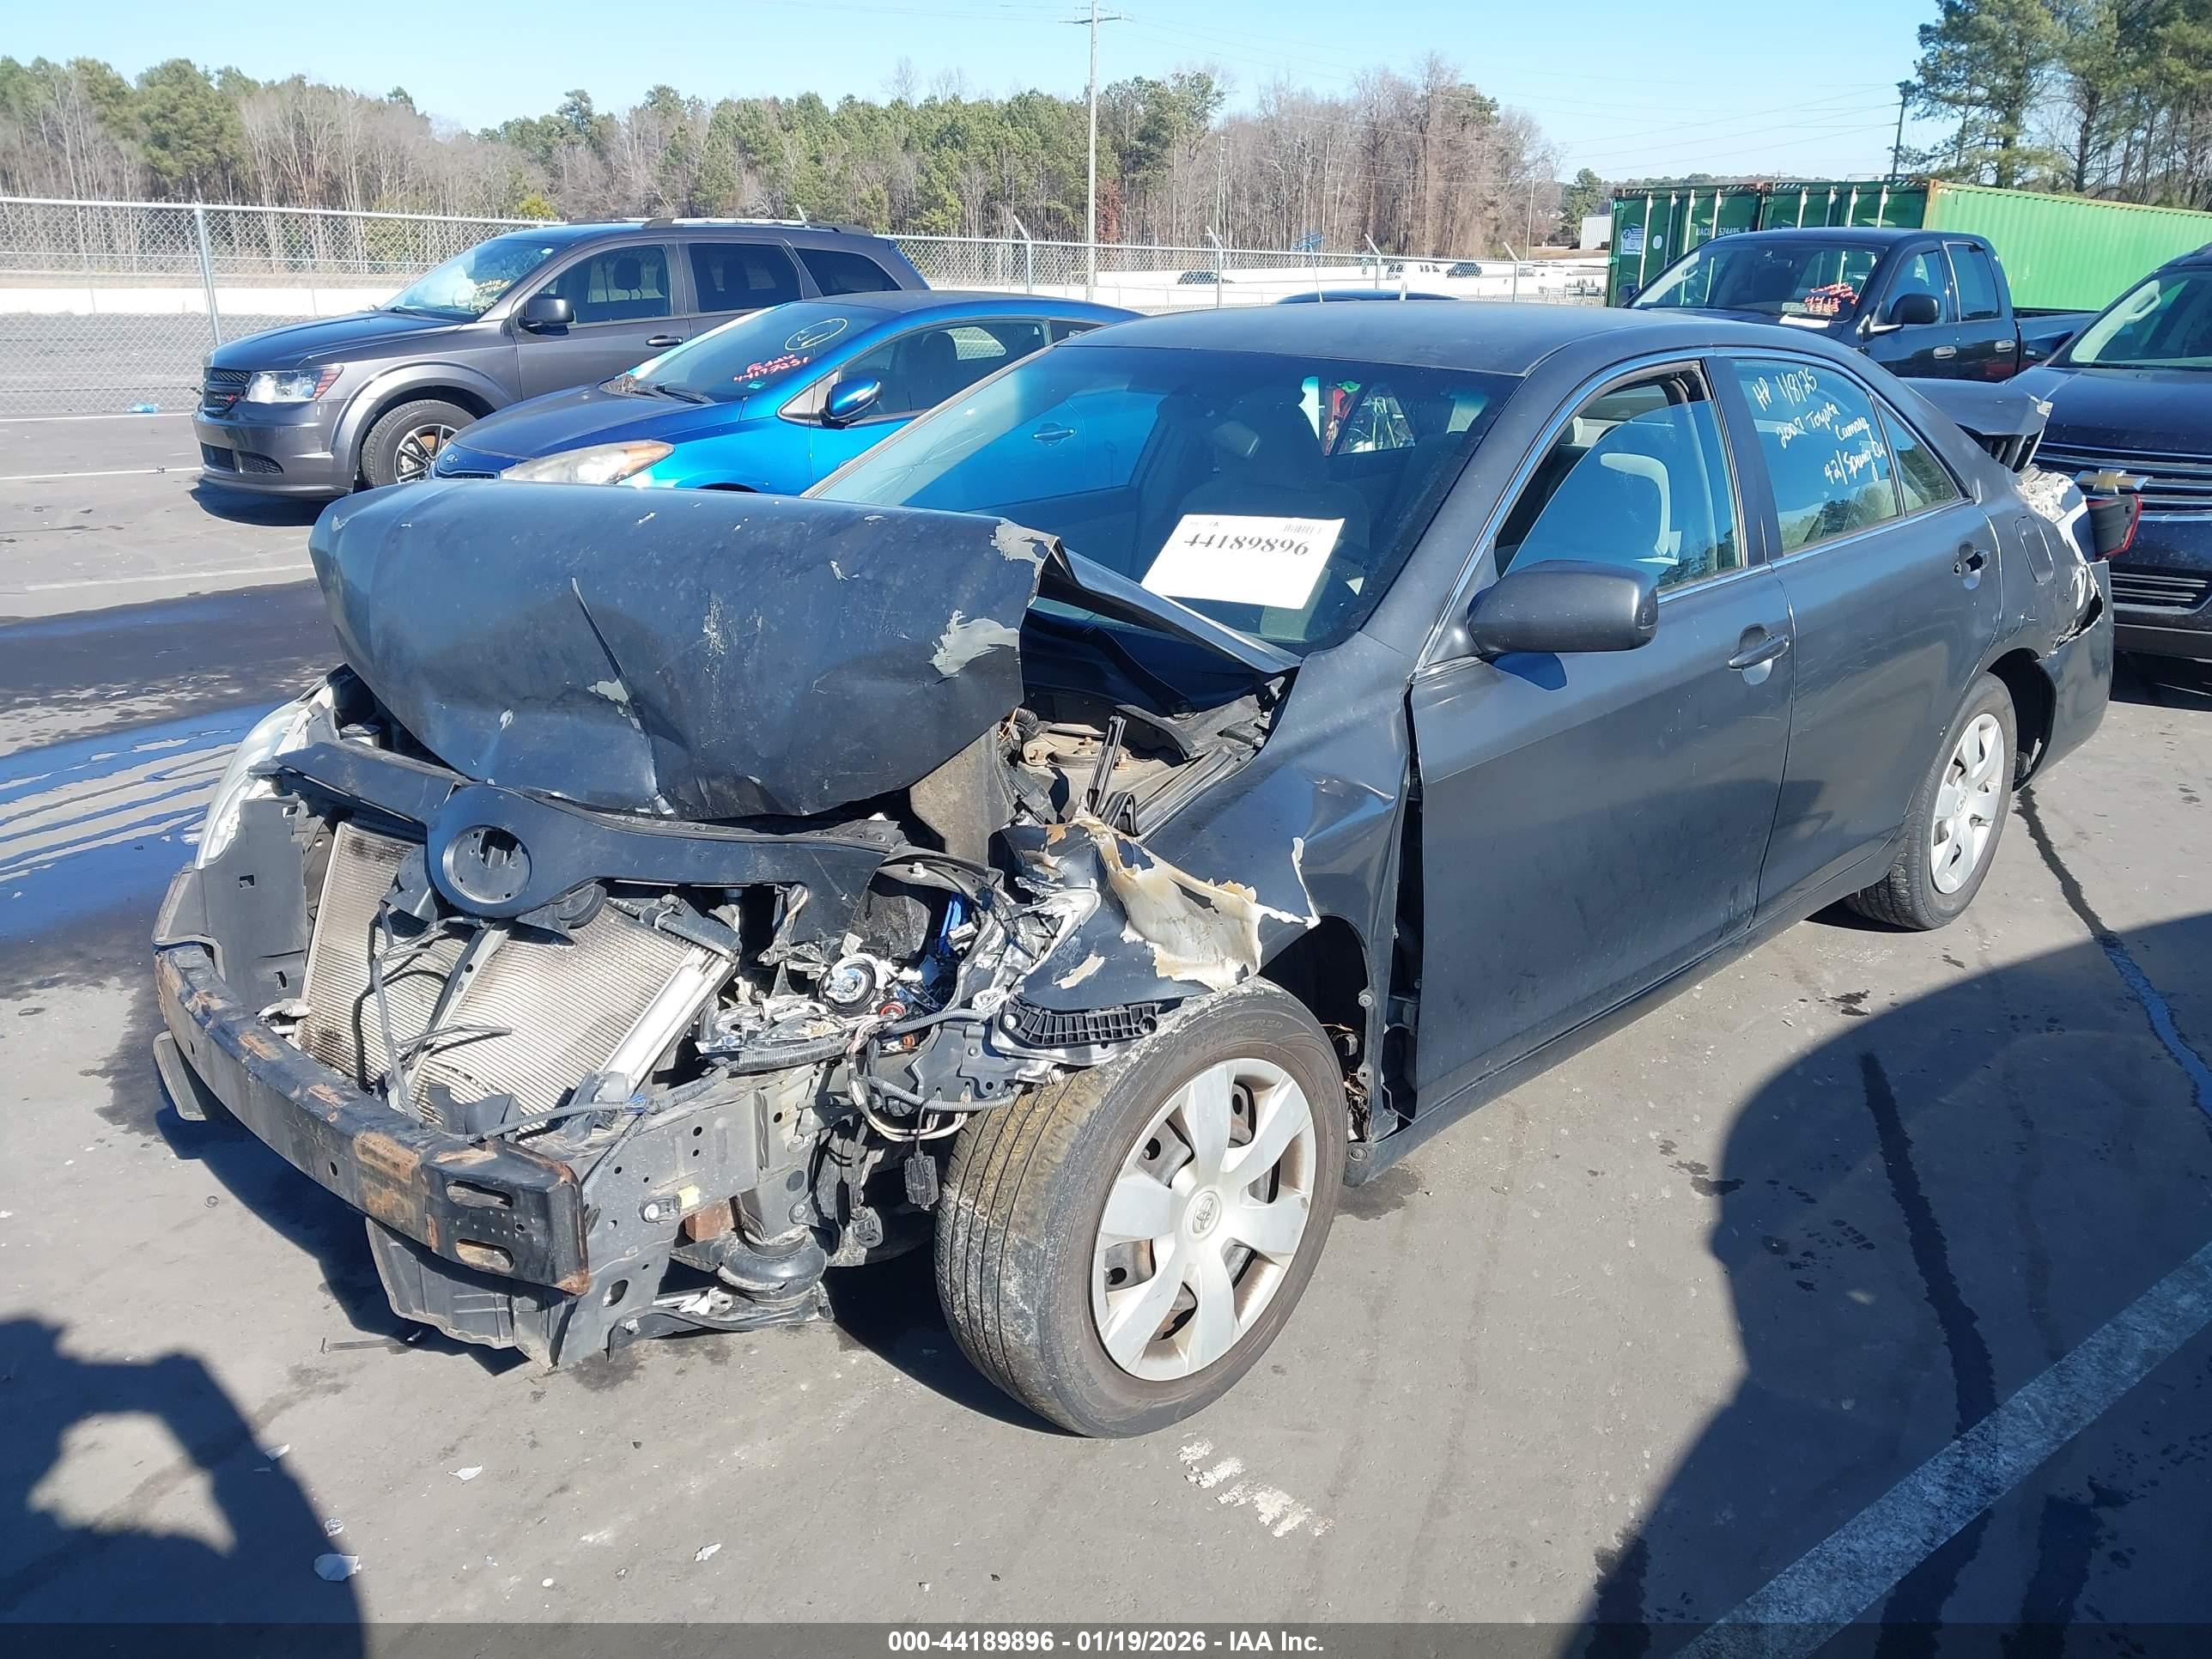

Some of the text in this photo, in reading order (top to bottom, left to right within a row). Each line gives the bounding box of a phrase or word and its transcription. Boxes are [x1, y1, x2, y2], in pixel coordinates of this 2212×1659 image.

[1777, 402, 1841, 449] 2007 Toyota
[1184, 533, 1310, 556] 44189896
